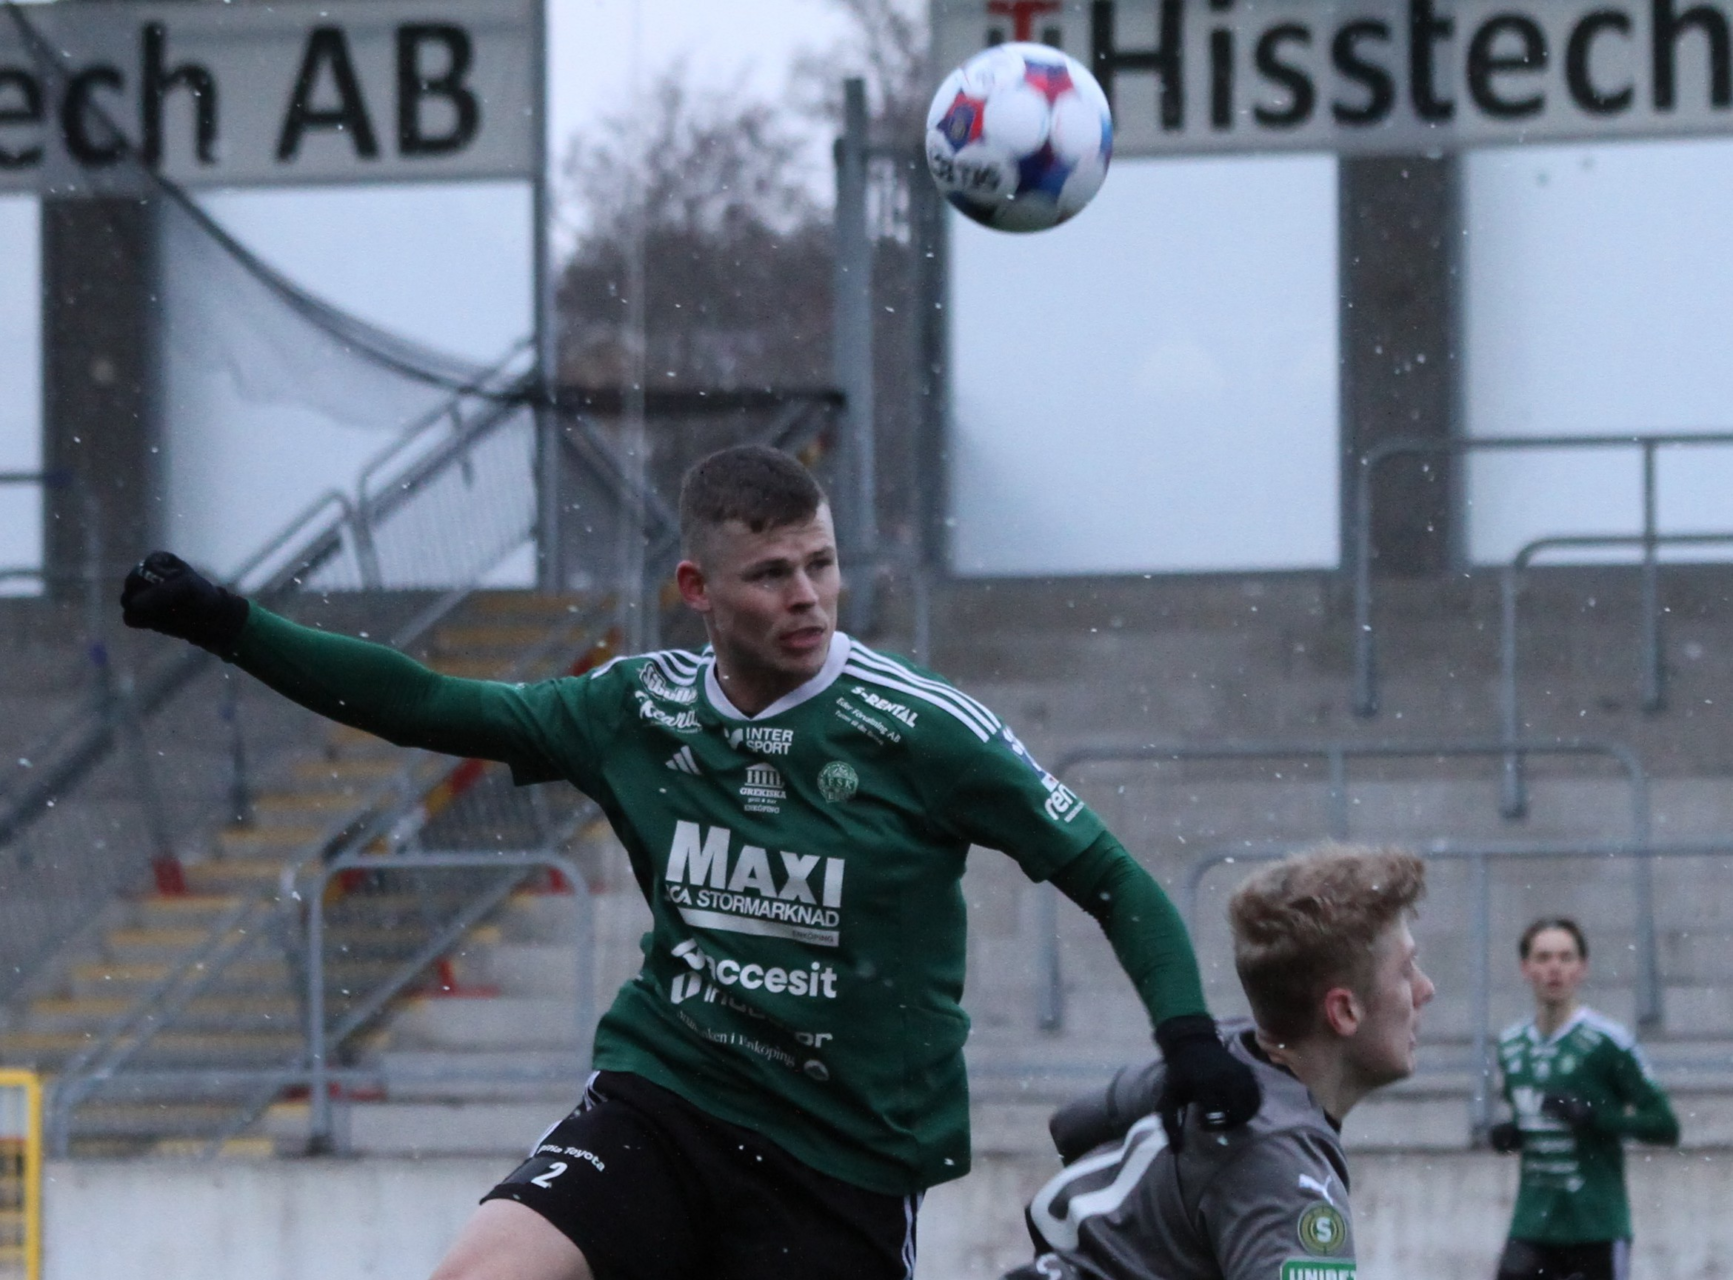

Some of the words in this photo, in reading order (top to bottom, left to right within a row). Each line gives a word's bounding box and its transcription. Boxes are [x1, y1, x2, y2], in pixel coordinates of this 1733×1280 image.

[1091, 0, 1733, 130] Hisstech
[277, 23, 483, 164] AB
[851, 686, 918, 728] S-RENTAL
[746, 727, 794, 742] INTER
[746, 740, 792, 755] SPORT
[740, 787, 787, 799] GREKISKA
[665, 820, 845, 908] MAXI
[697, 889, 839, 927] STORMARKNAD
[564, 1146, 605, 1172] Toyota
[531, 1162, 568, 1188] 2
[1315, 1217, 1332, 1243] S
